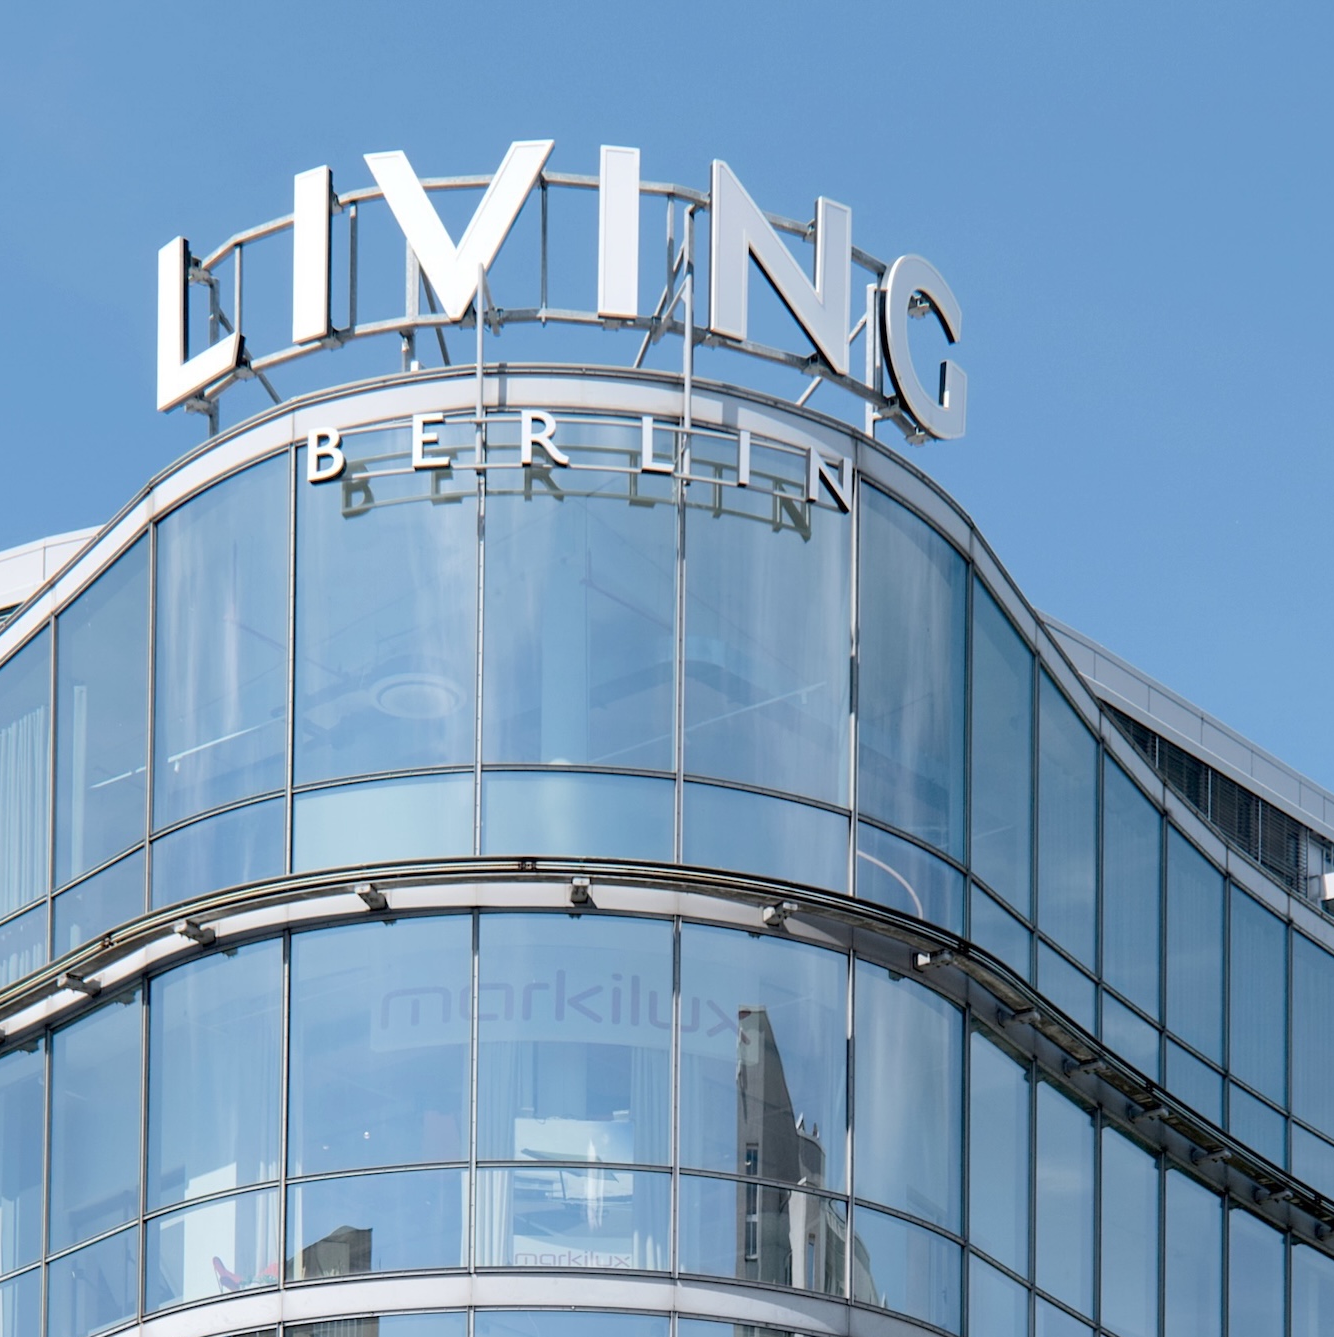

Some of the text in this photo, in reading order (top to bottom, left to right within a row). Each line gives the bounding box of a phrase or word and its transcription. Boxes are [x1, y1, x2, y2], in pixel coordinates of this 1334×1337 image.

[157, 139, 967, 441] LIVING
[306, 409, 852, 515] BERLIN
[380, 969, 751, 1045] markilux
[514, 1250, 631, 1267] markilux
